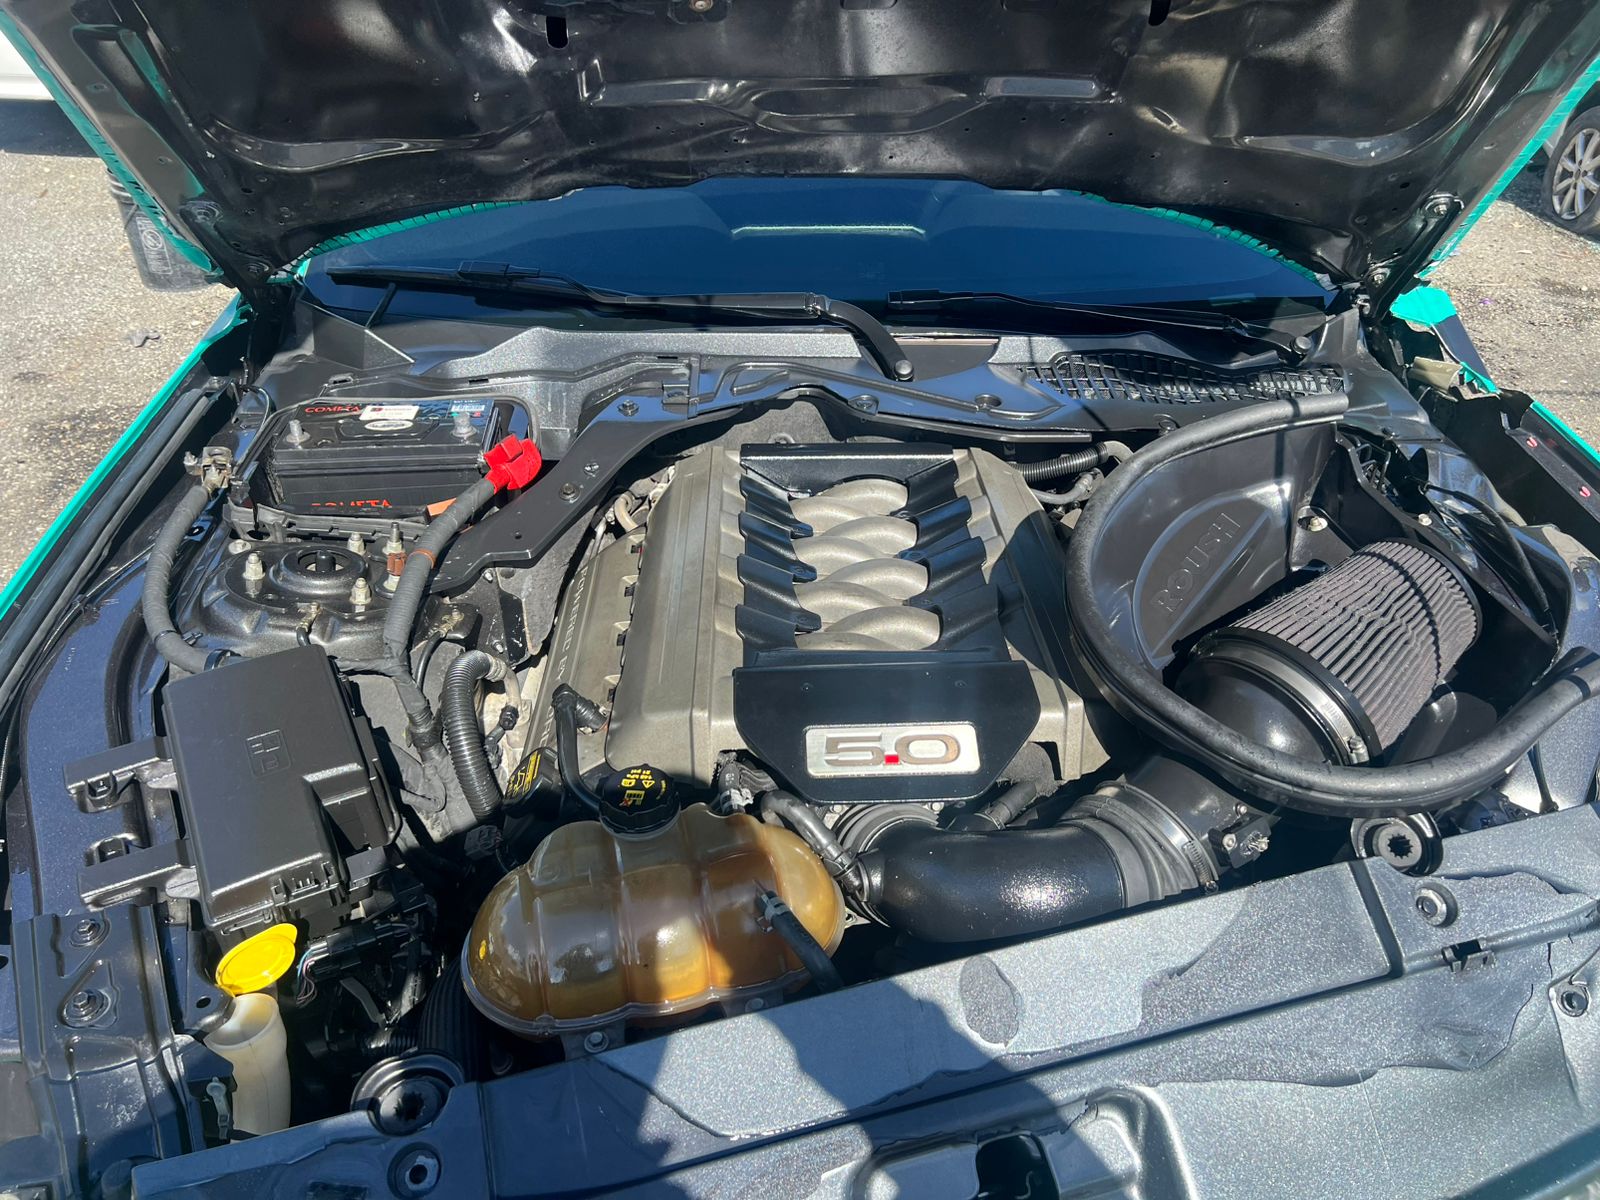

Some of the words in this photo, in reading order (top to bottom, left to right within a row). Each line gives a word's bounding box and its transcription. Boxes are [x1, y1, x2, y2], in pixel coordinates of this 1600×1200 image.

[1150, 512, 1242, 614] ROUSH
[562, 565, 589, 653] POWERED
[823, 731, 962, 767] 5.0
